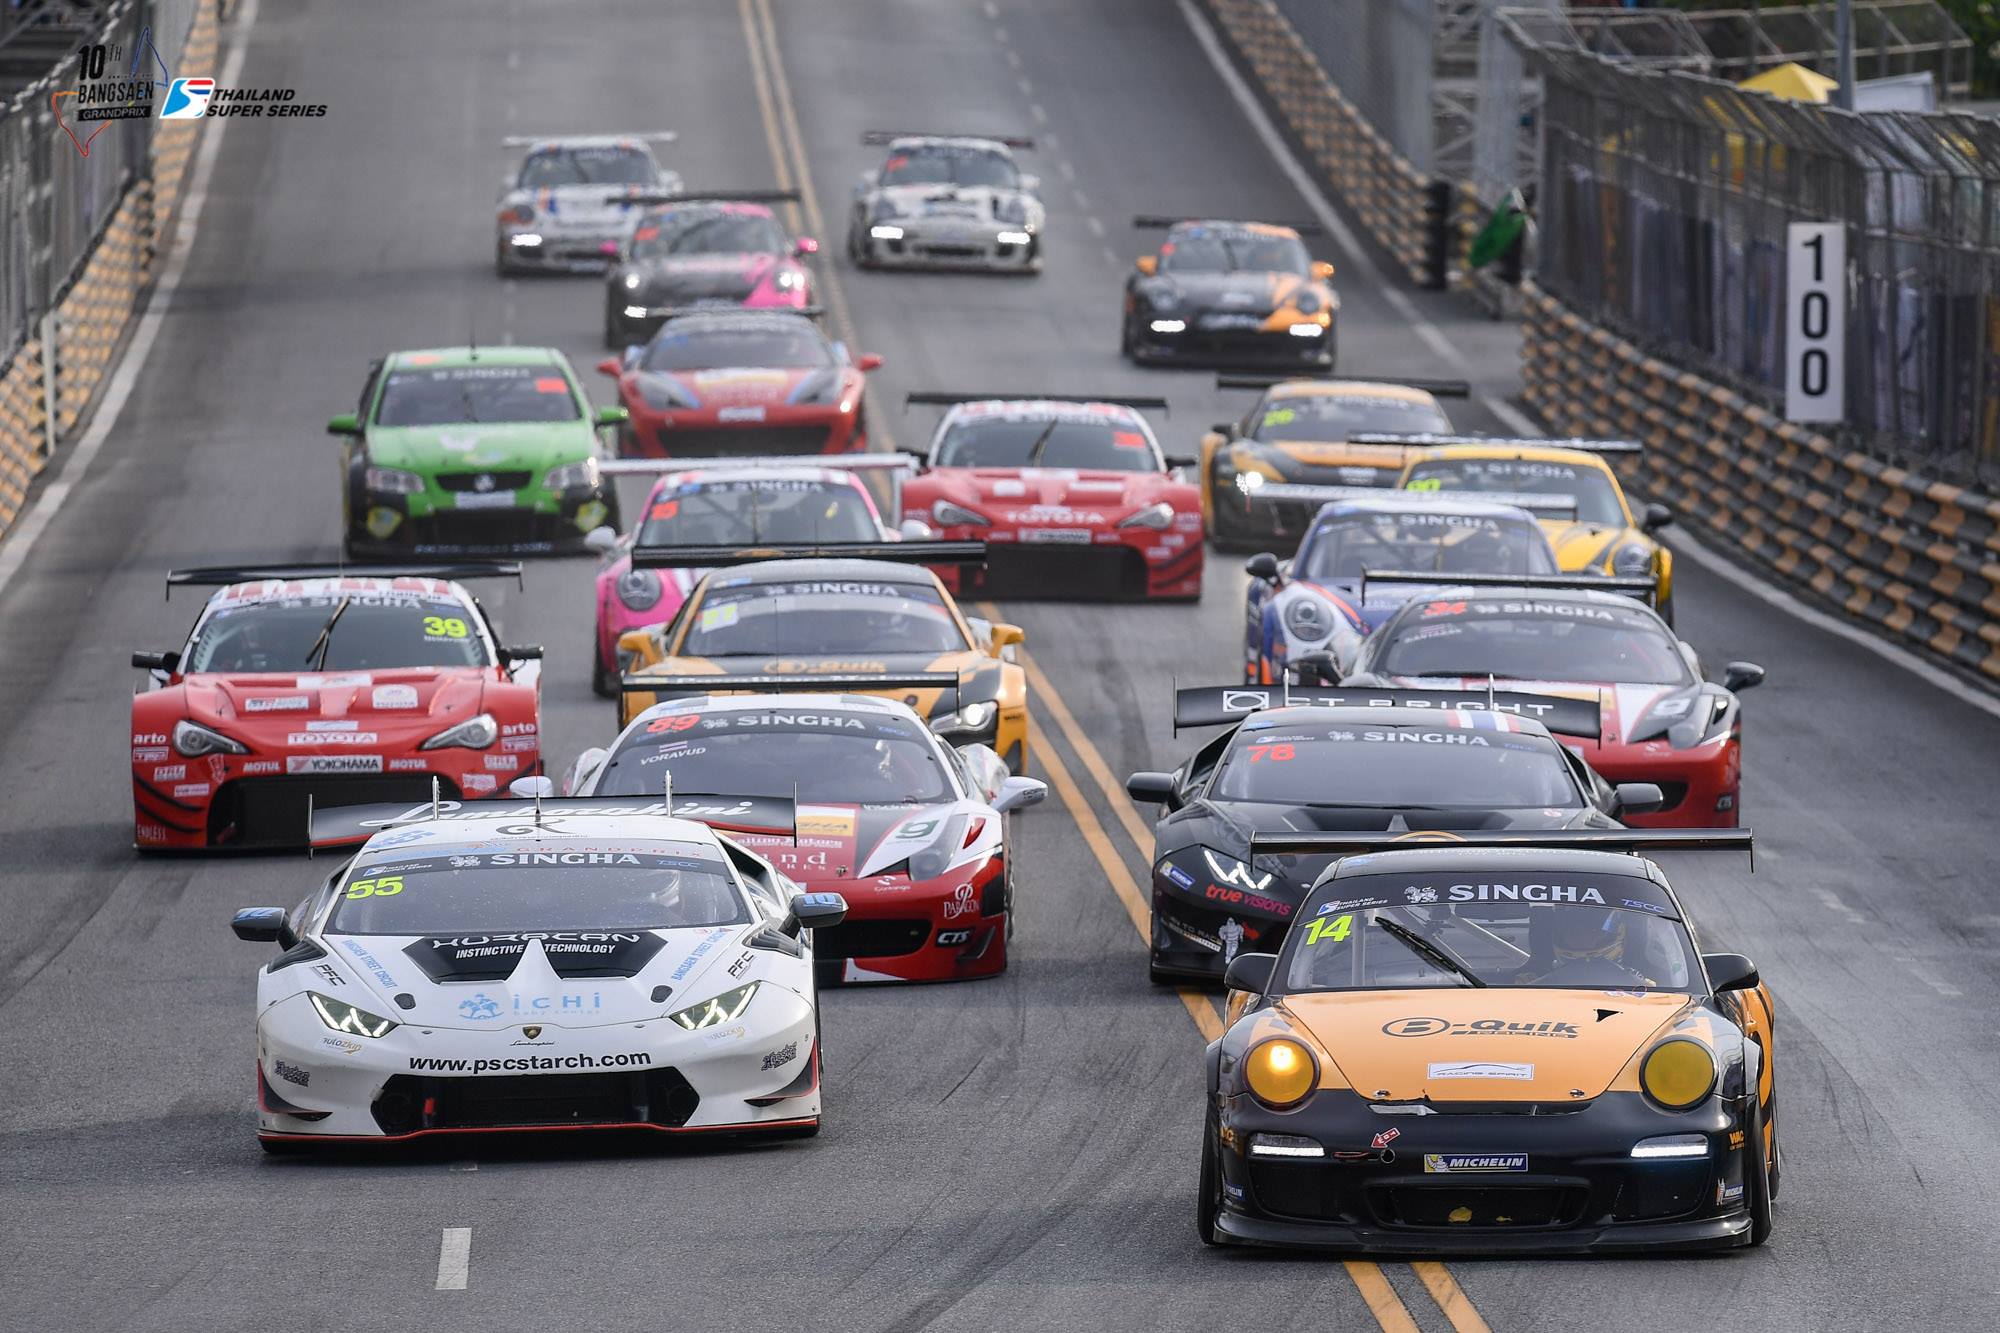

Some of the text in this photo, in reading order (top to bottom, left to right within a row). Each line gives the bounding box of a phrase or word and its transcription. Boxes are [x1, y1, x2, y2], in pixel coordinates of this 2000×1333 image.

[1802, 234, 1829, 396] 100
[1401, 514, 1498, 530] SINGHA
[793, 582, 899, 596] SINGHA
[310, 595, 423, 609] SINGHA
[1503, 602, 1615, 621] SINGHA
[423, 616, 469, 638] 39
[502, 723, 536, 736] arto
[647, 714, 701, 733] 89
[737, 715, 867, 730] SINGHA
[134, 732, 167, 745] arto
[293, 733, 374, 743] TOYOTA
[1363, 731, 1490, 746] SINGHA
[389, 758, 427, 770] MOTUL
[640, 746, 707, 766] VORAVUD
[243, 761, 280, 773] MOTUL
[311, 758, 379, 771] YOKOHAMA
[490, 853, 641, 866] SINGHA
[346, 876, 404, 899] 55
[1448, 884, 1606, 904] SINGHA
[1205, 883, 1293, 916] true visions
[1305, 915, 1353, 945] 14
[455, 943, 616, 959] INSTINCTIVE TECHNOLOGY
[727, 950, 755, 978] PFC
[315, 963, 346, 986] PFC
[409, 1052, 652, 1076] www.pscstarch.com
[1449, 1157, 1524, 1168] MICHELIN
